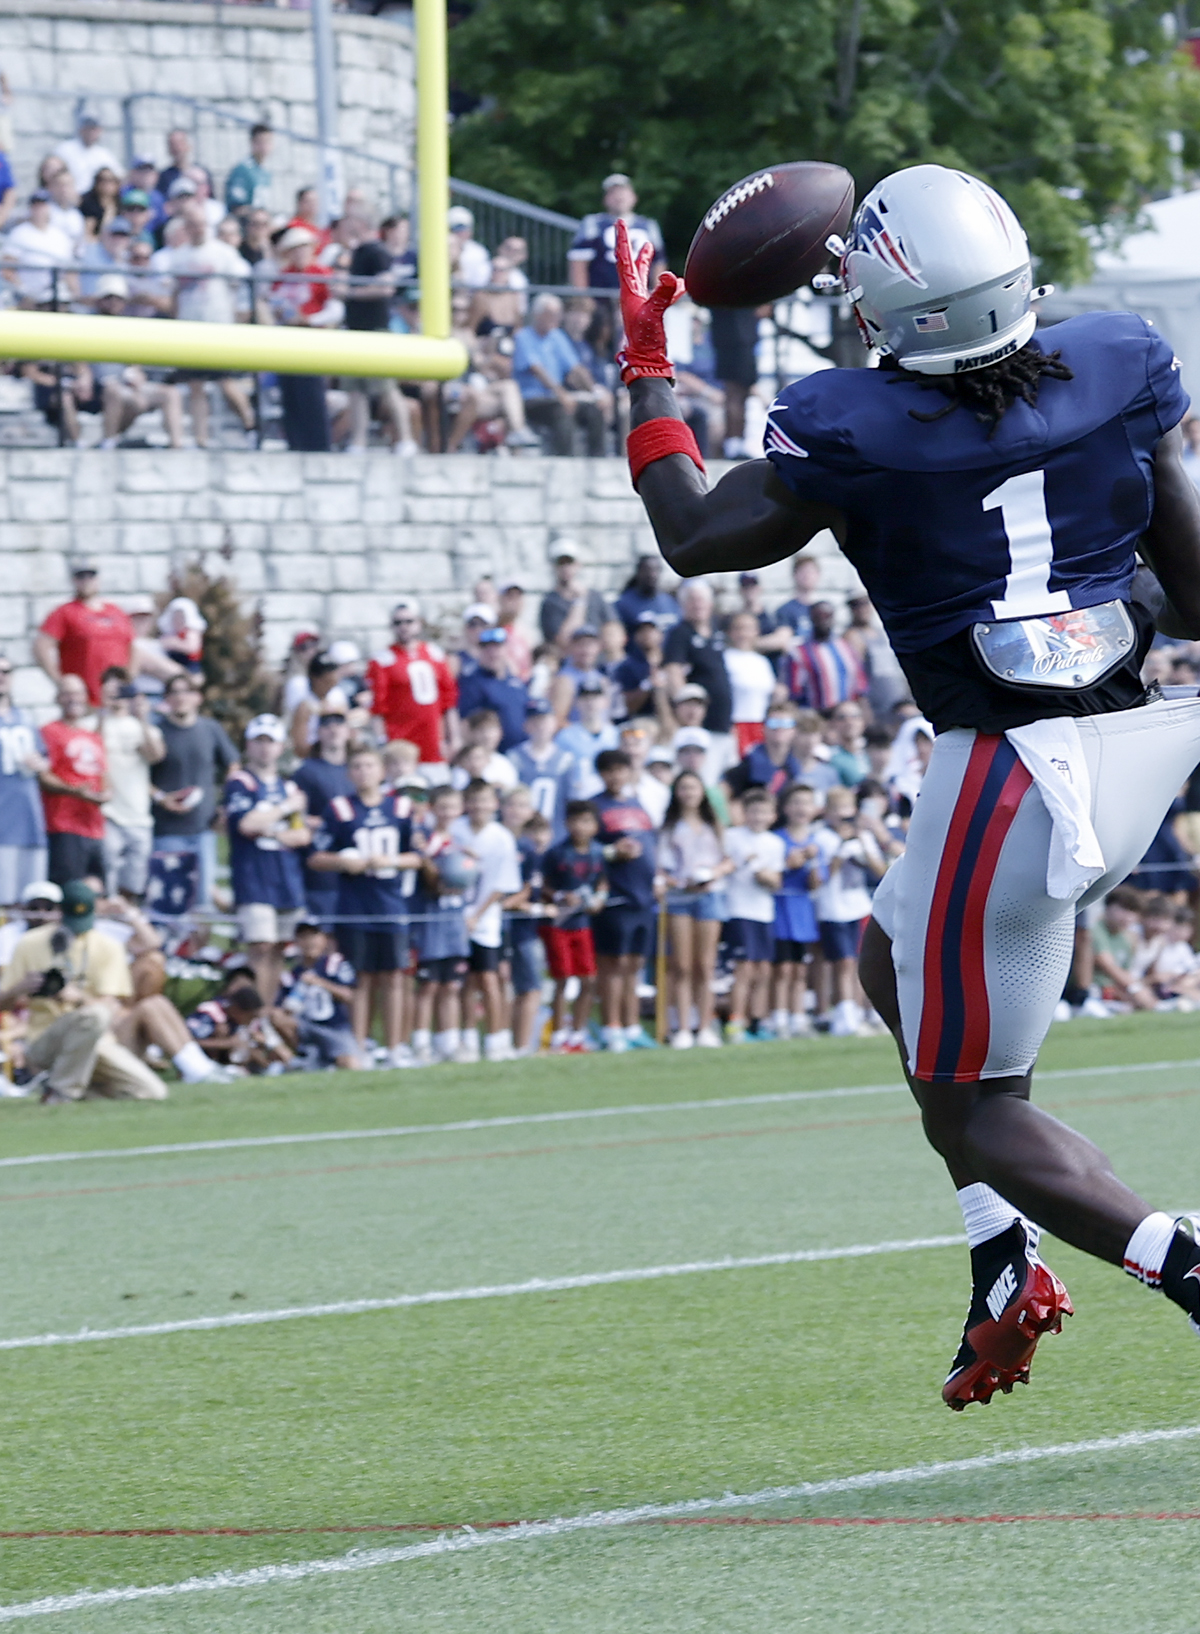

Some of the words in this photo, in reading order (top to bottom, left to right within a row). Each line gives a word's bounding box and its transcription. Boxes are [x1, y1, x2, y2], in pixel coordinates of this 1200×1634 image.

[988, 309, 998, 333] 1
[954, 338, 1018, 373] PATRIOTS
[982, 469, 1073, 620] 1
[1032, 644, 1104, 677] Patriots
[407, 660, 439, 705] 0
[985, 1262, 1018, 1323] NIKE
